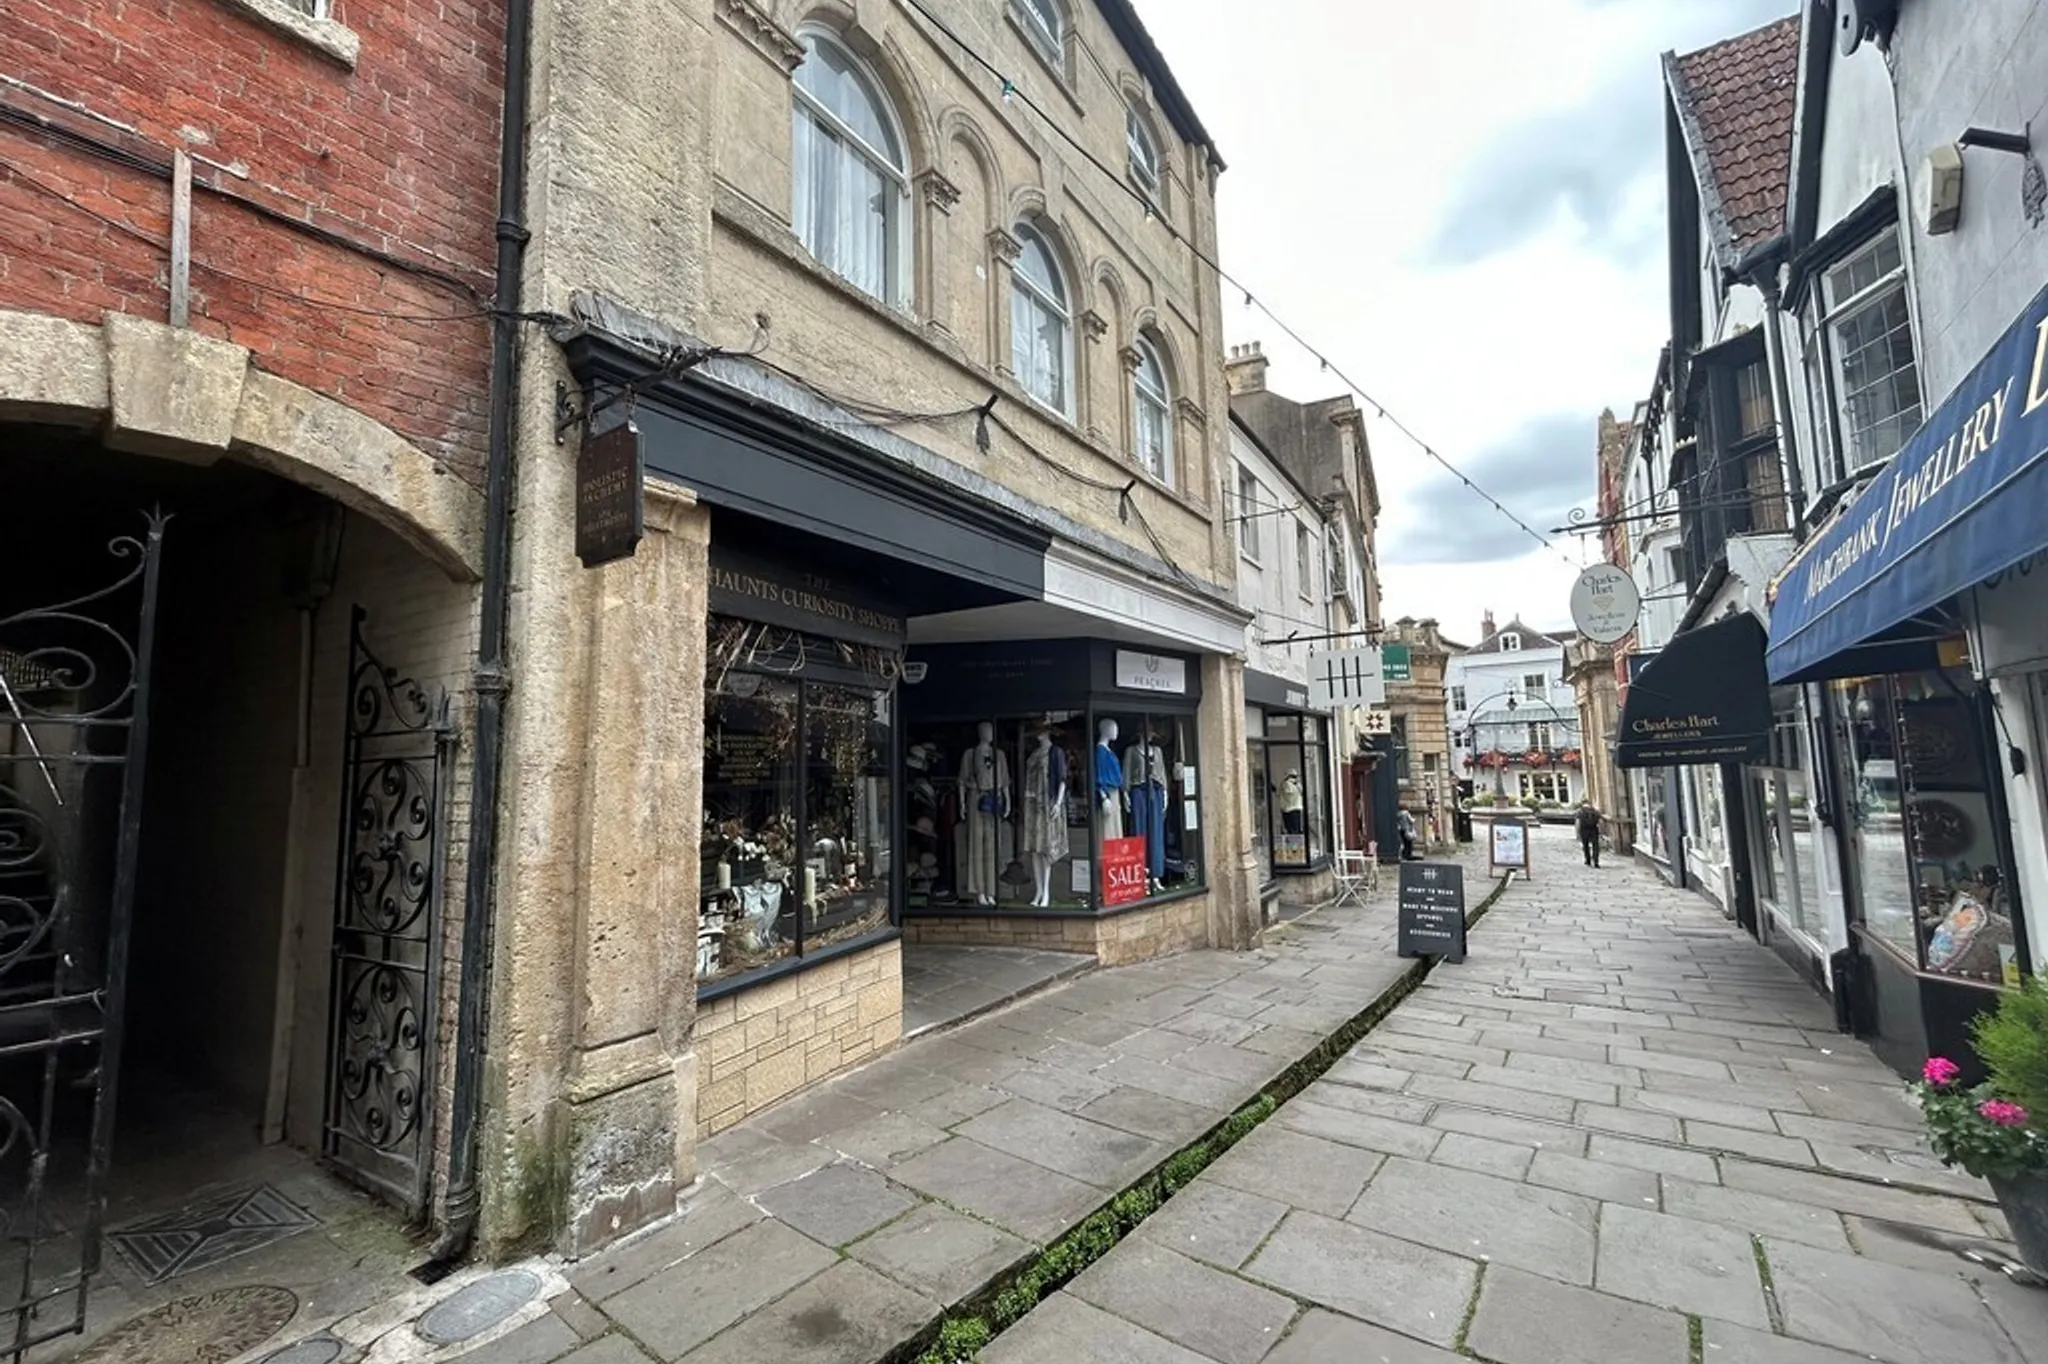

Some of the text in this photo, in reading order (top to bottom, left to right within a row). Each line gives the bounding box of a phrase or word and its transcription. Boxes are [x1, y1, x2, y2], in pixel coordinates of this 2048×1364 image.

[1803, 374, 2015, 604] MARCHBANK JEWELLERY
[781, 587, 856, 622] CURIOSITY
[1632, 714, 1720, 733] Charles Hart
[1107, 863, 1142, 888] SALE
